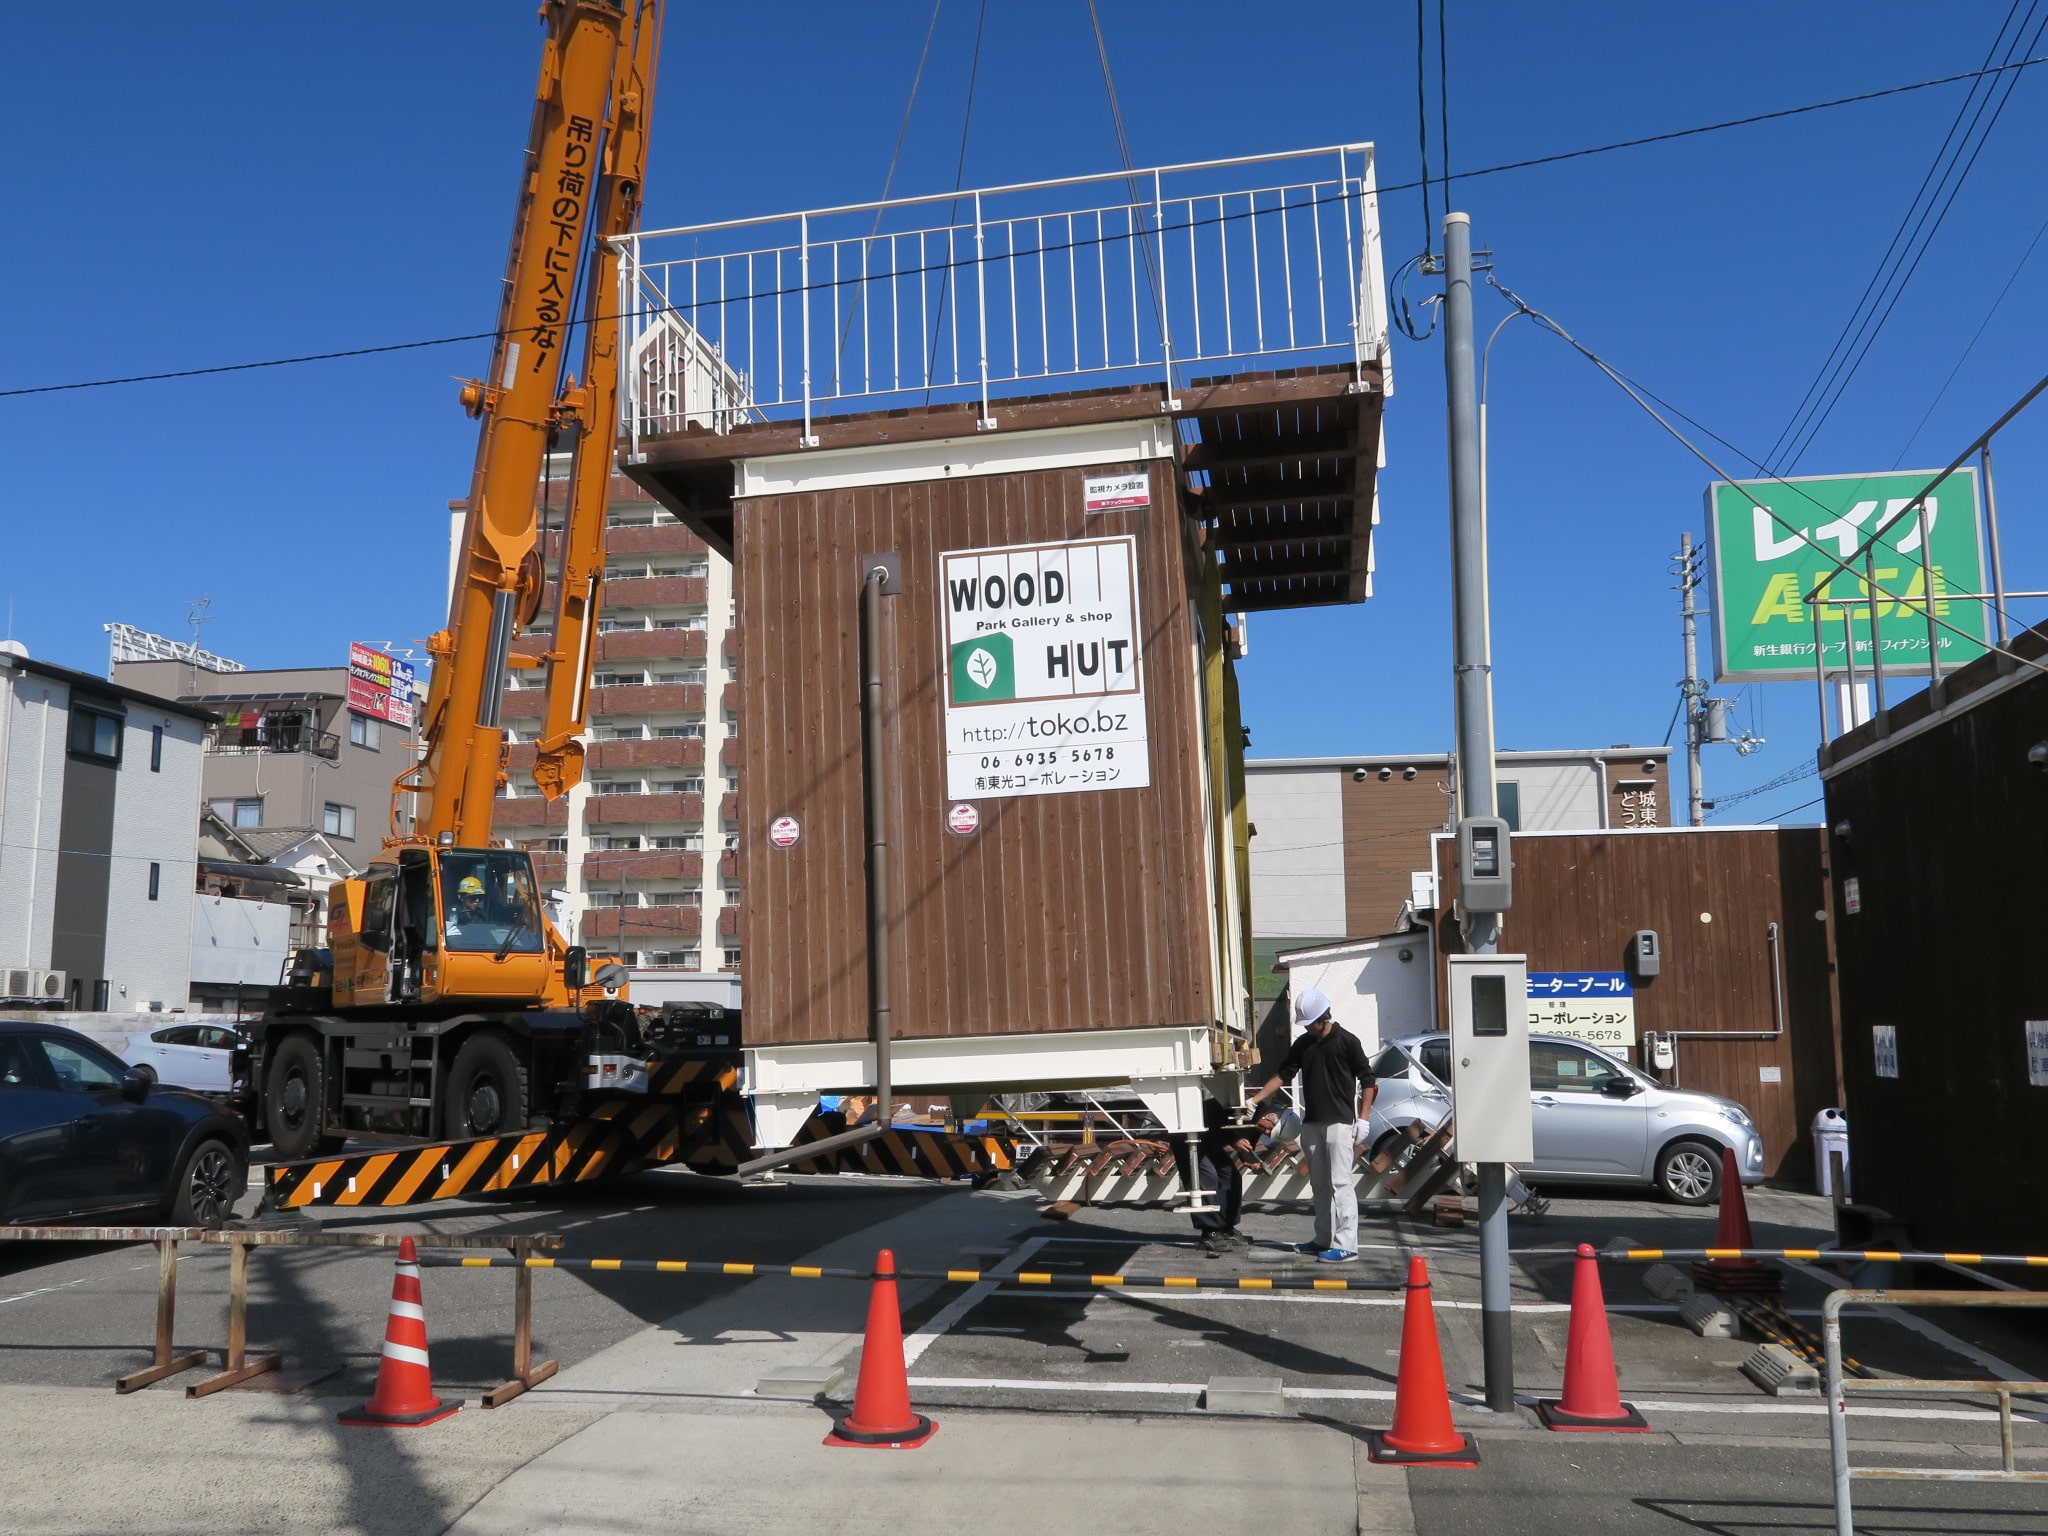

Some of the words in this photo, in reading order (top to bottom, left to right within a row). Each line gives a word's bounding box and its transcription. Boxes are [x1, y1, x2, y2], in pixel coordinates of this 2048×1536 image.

[531, 115, 594, 374] 吊り荷の下に入るな！
[1752, 496, 1938, 562] レイク
[949, 570, 1064, 613] WOOD
[1751, 565, 1950, 625] ALSA
[976, 619, 1007, 631] Park
[1011, 615, 1060, 629] Gallery
[1065, 613, 1075, 623] &
[1080, 611, 1112, 624] shop
[1046, 639, 1129, 679] HUT
[1621, 790, 1639, 829] どう
[1638, 790, 1658, 829] 城東
